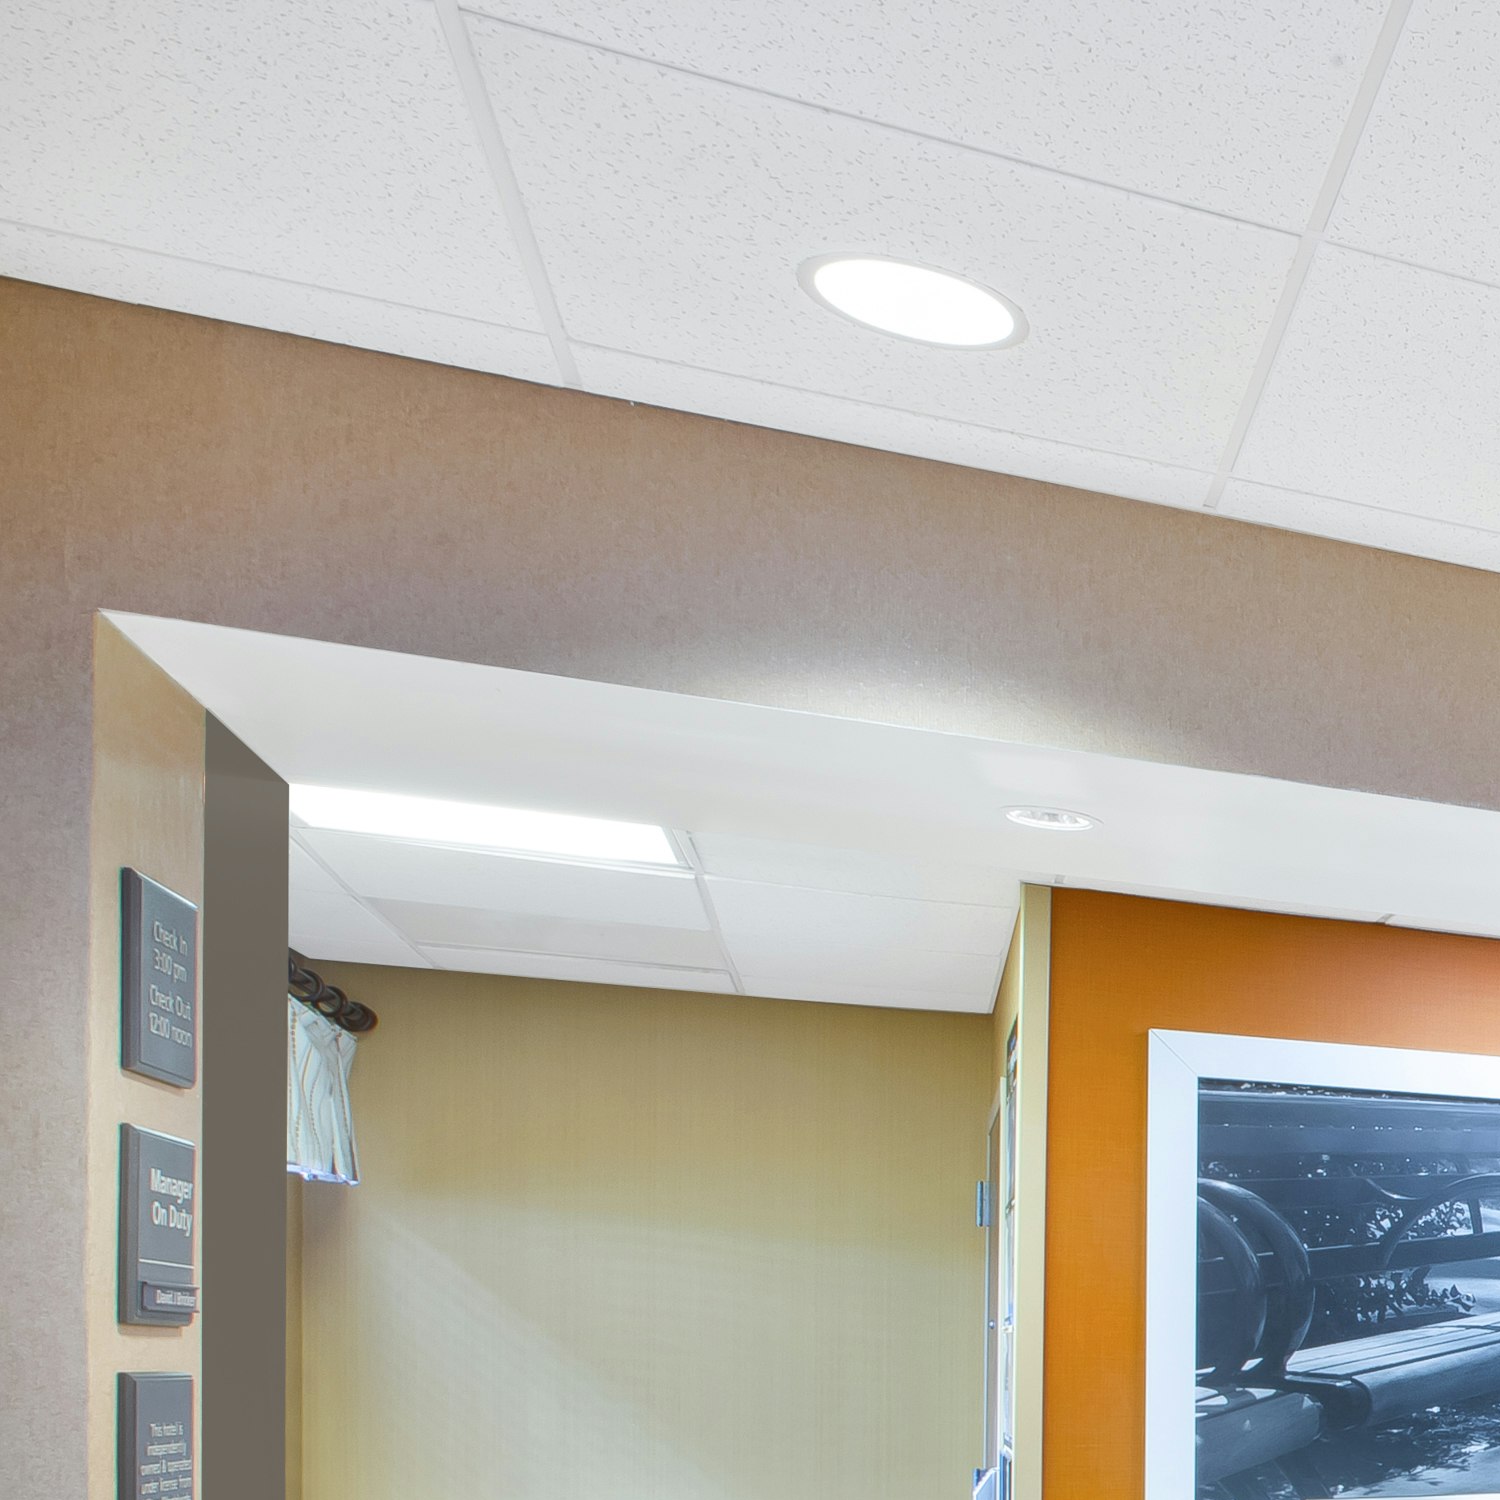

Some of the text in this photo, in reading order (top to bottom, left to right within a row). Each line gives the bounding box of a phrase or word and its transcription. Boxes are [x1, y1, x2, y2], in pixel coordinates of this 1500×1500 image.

[153, 920, 188, 957] Check In
[153, 947, 187, 983] 3:00 pm
[150, 984, 192, 1021] Check Out
[149, 1011, 193, 1048] 12:00 noon
[150, 1167, 193, 1204] Manager
[152, 1201, 193, 1237] On Duty
